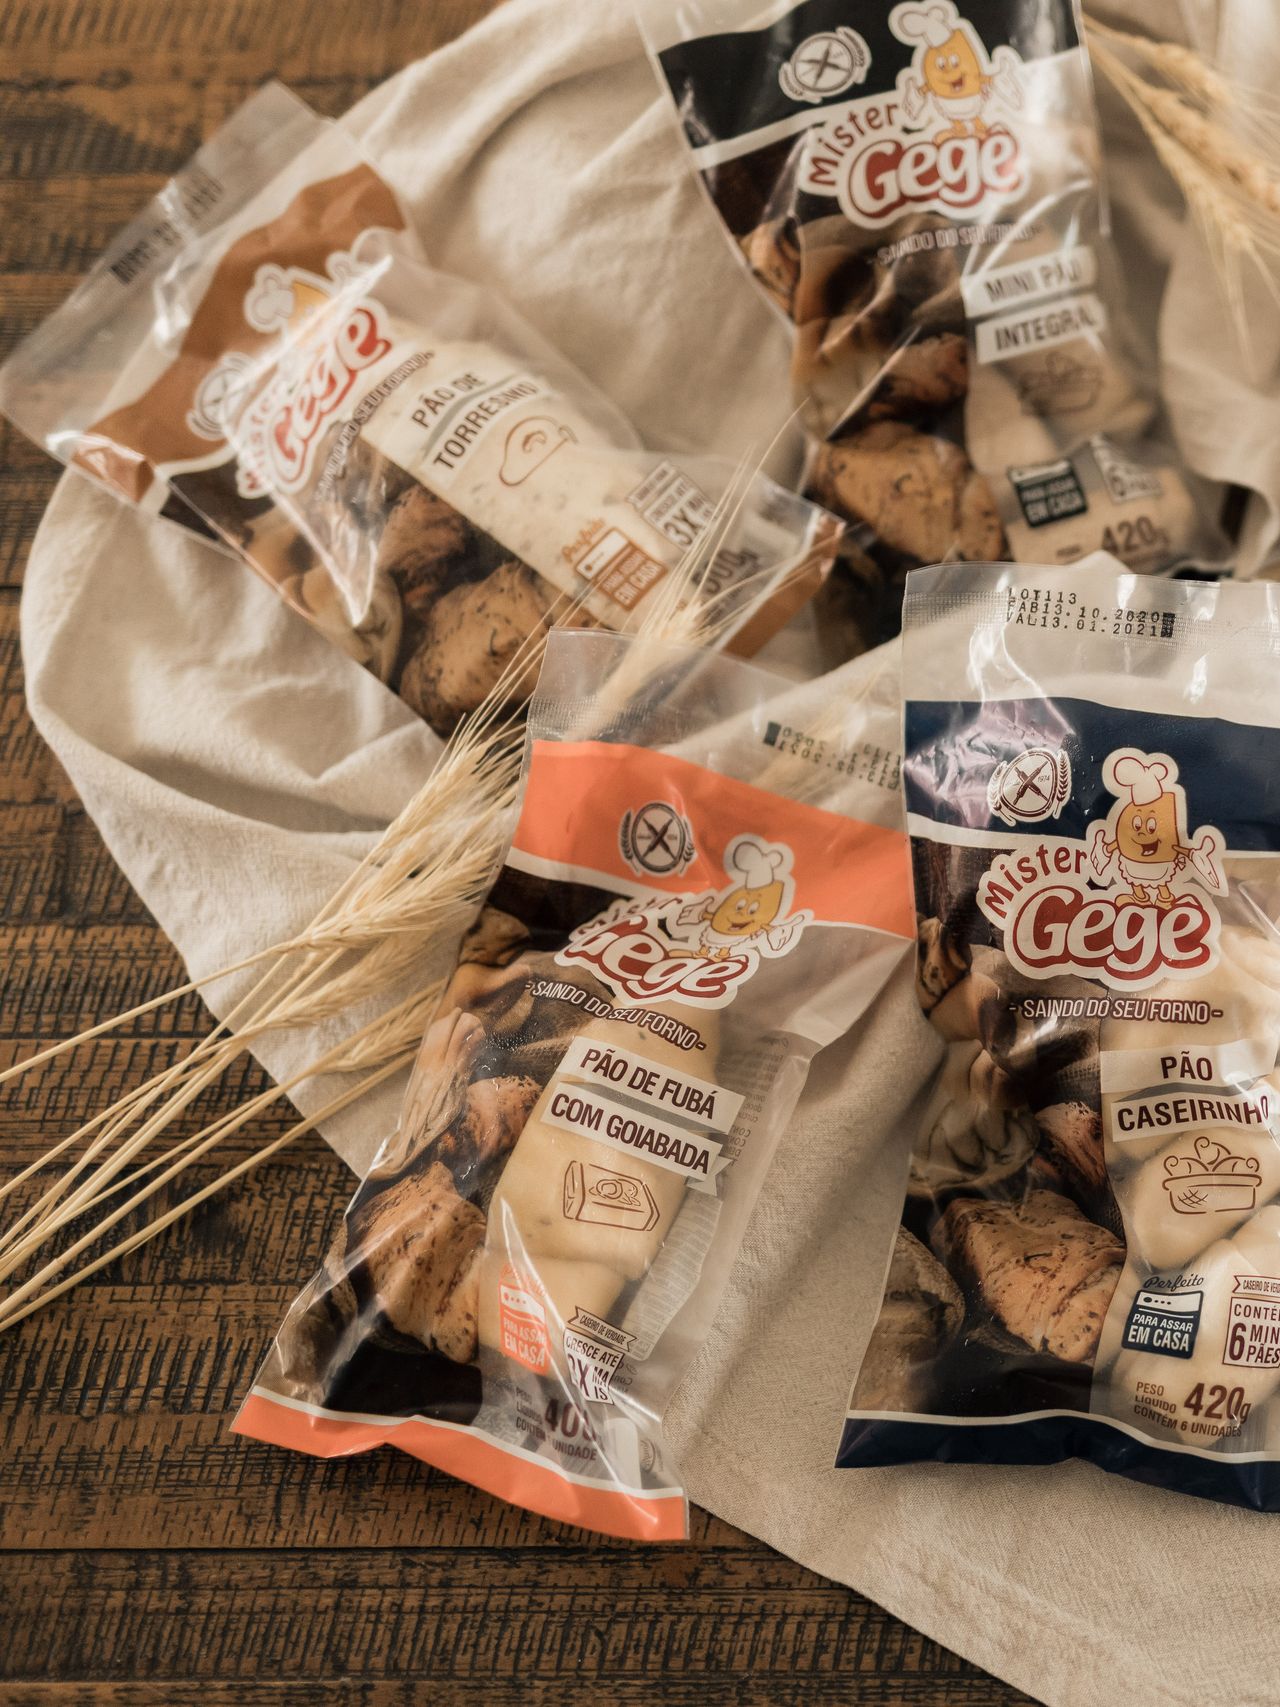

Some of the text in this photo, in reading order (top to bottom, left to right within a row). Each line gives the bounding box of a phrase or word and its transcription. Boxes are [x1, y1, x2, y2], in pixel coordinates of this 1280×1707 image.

[808, 103, 899, 187] Mister
[994, 305, 1095, 351] INTEGRAL
[411, 392, 455, 429] PÃO
[984, 844, 1087, 919] Mister
[533, 981, 698, 1050] SAINDO DO SEU FORNO
[1024, 998, 1211, 1024] SAINDO DO SEU FORNO
[1160, 1050, 1213, 1081] PÃO
[580, 1048, 719, 1120] PÃO DE FUBÁ
[1117, 1095, 1269, 1131] CASEIRINHO
[551, 1093, 711, 1175] COM GOIABADA
[1143, 1273, 1204, 1292] Perfeito
[1242, 1280, 1263, 1292] CASEIRO
[1263, 1282, 1270, 1292] DE
[1127, 1325, 1190, 1352] EM CASA
[1132, 1313, 1194, 1333] PARA ASSAR
[518, 1340, 546, 1368] CASA
[566, 1335, 620, 1368] CRESCE ATÉ
[1228, 1322, 1247, 1361] 6
[595, 1387, 608, 1400] IS
[1135, 1395, 1177, 1415] LÍQUIDO
[1136, 1381, 1165, 1397] PESO
[1183, 1382, 1252, 1424] 420g
[1134, 1405, 1243, 1439] CONTÉM 6 UNIDADES
[552, 1439, 598, 1461] UNIDADE
